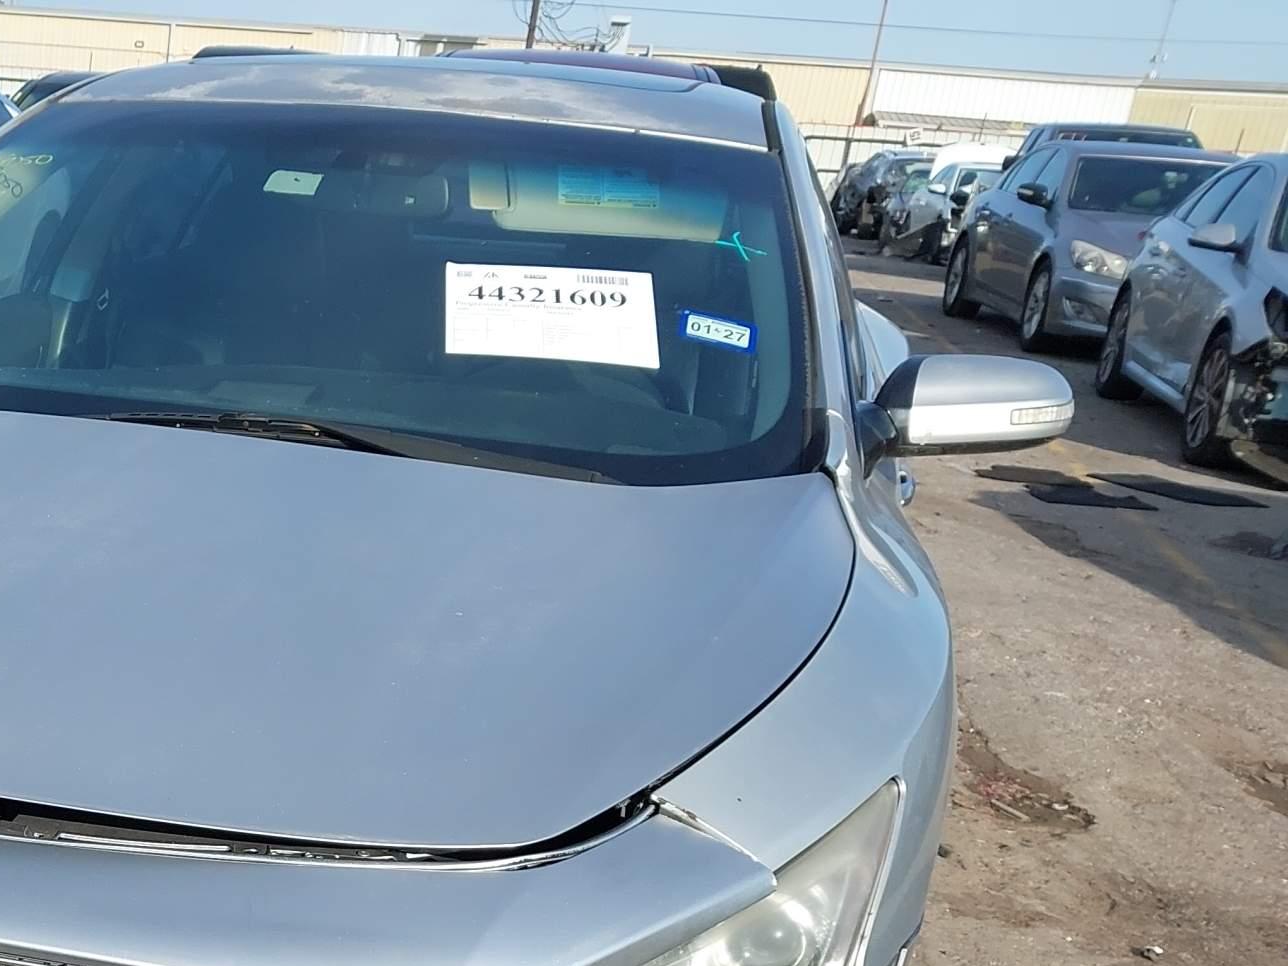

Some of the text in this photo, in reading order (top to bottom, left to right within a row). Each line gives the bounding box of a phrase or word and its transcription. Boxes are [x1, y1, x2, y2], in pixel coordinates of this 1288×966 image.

[467, 284, 628, 308] 44321609
[690, 321, 747, 342] 01 27
